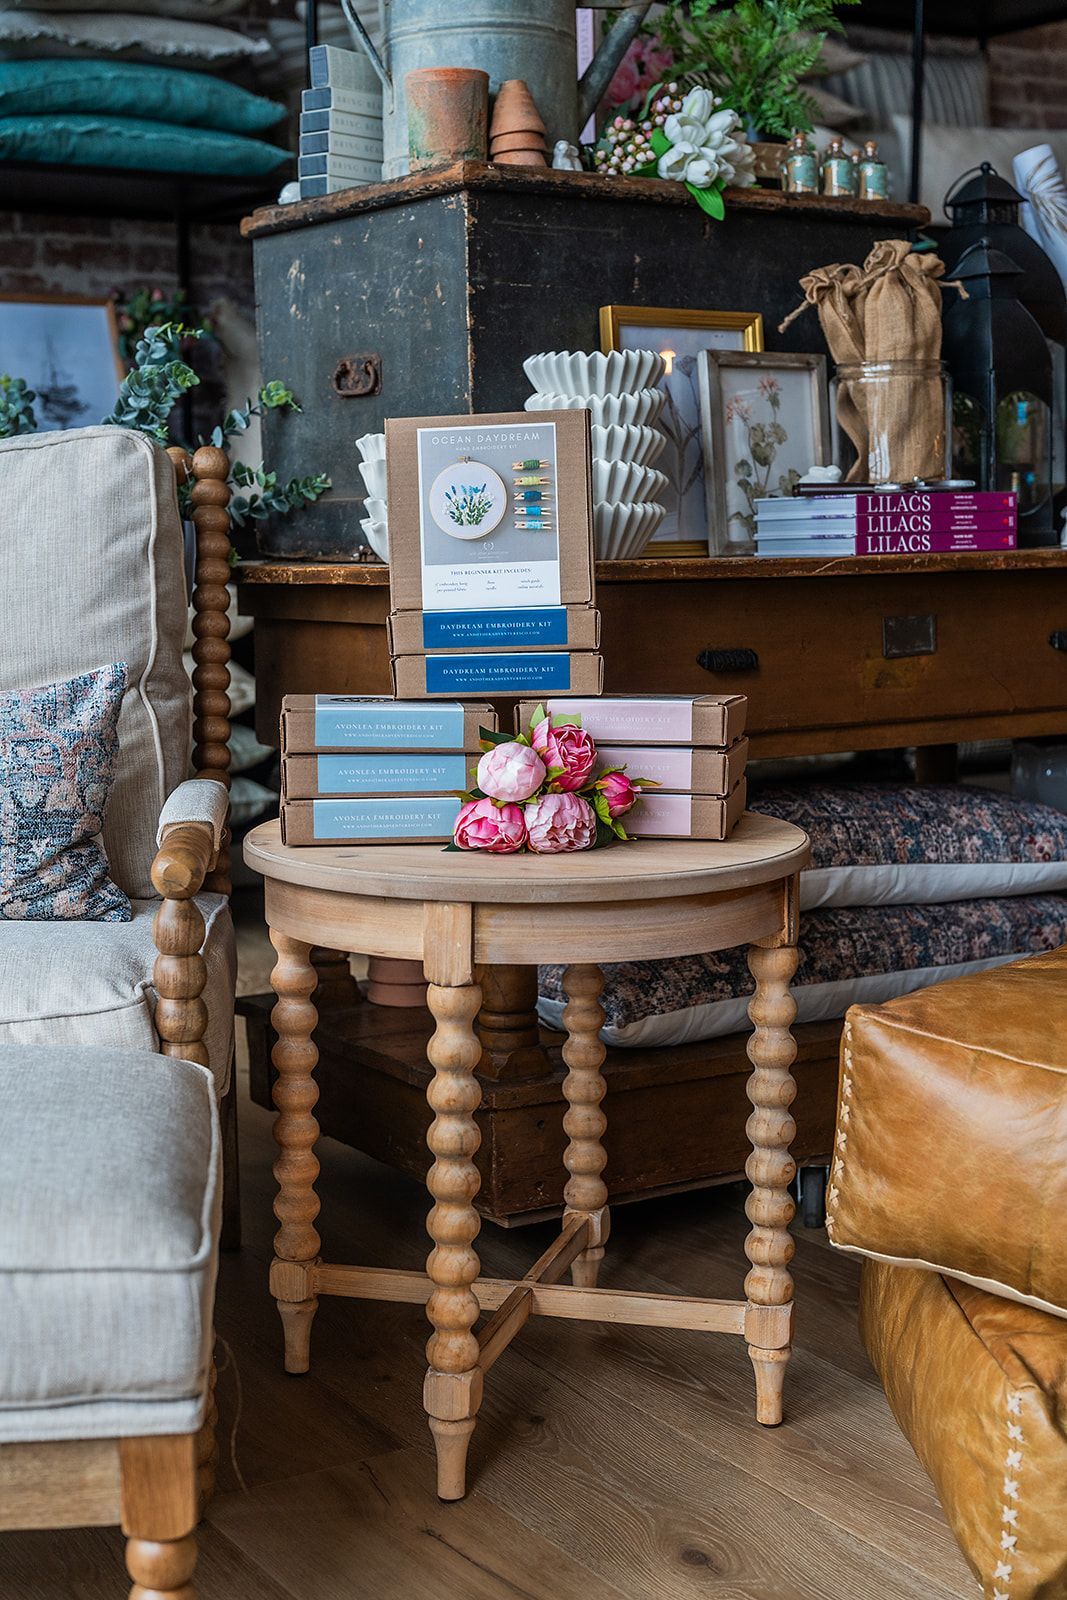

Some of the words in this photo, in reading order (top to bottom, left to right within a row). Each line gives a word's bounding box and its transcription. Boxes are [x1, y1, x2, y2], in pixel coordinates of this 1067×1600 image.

[432, 436, 471, 445] OCEAN
[477, 432, 540, 443] DAYDREAM
[867, 495, 931, 513] LILACS
[867, 515, 932, 533] LILACS
[867, 534, 931, 553] LILACS
